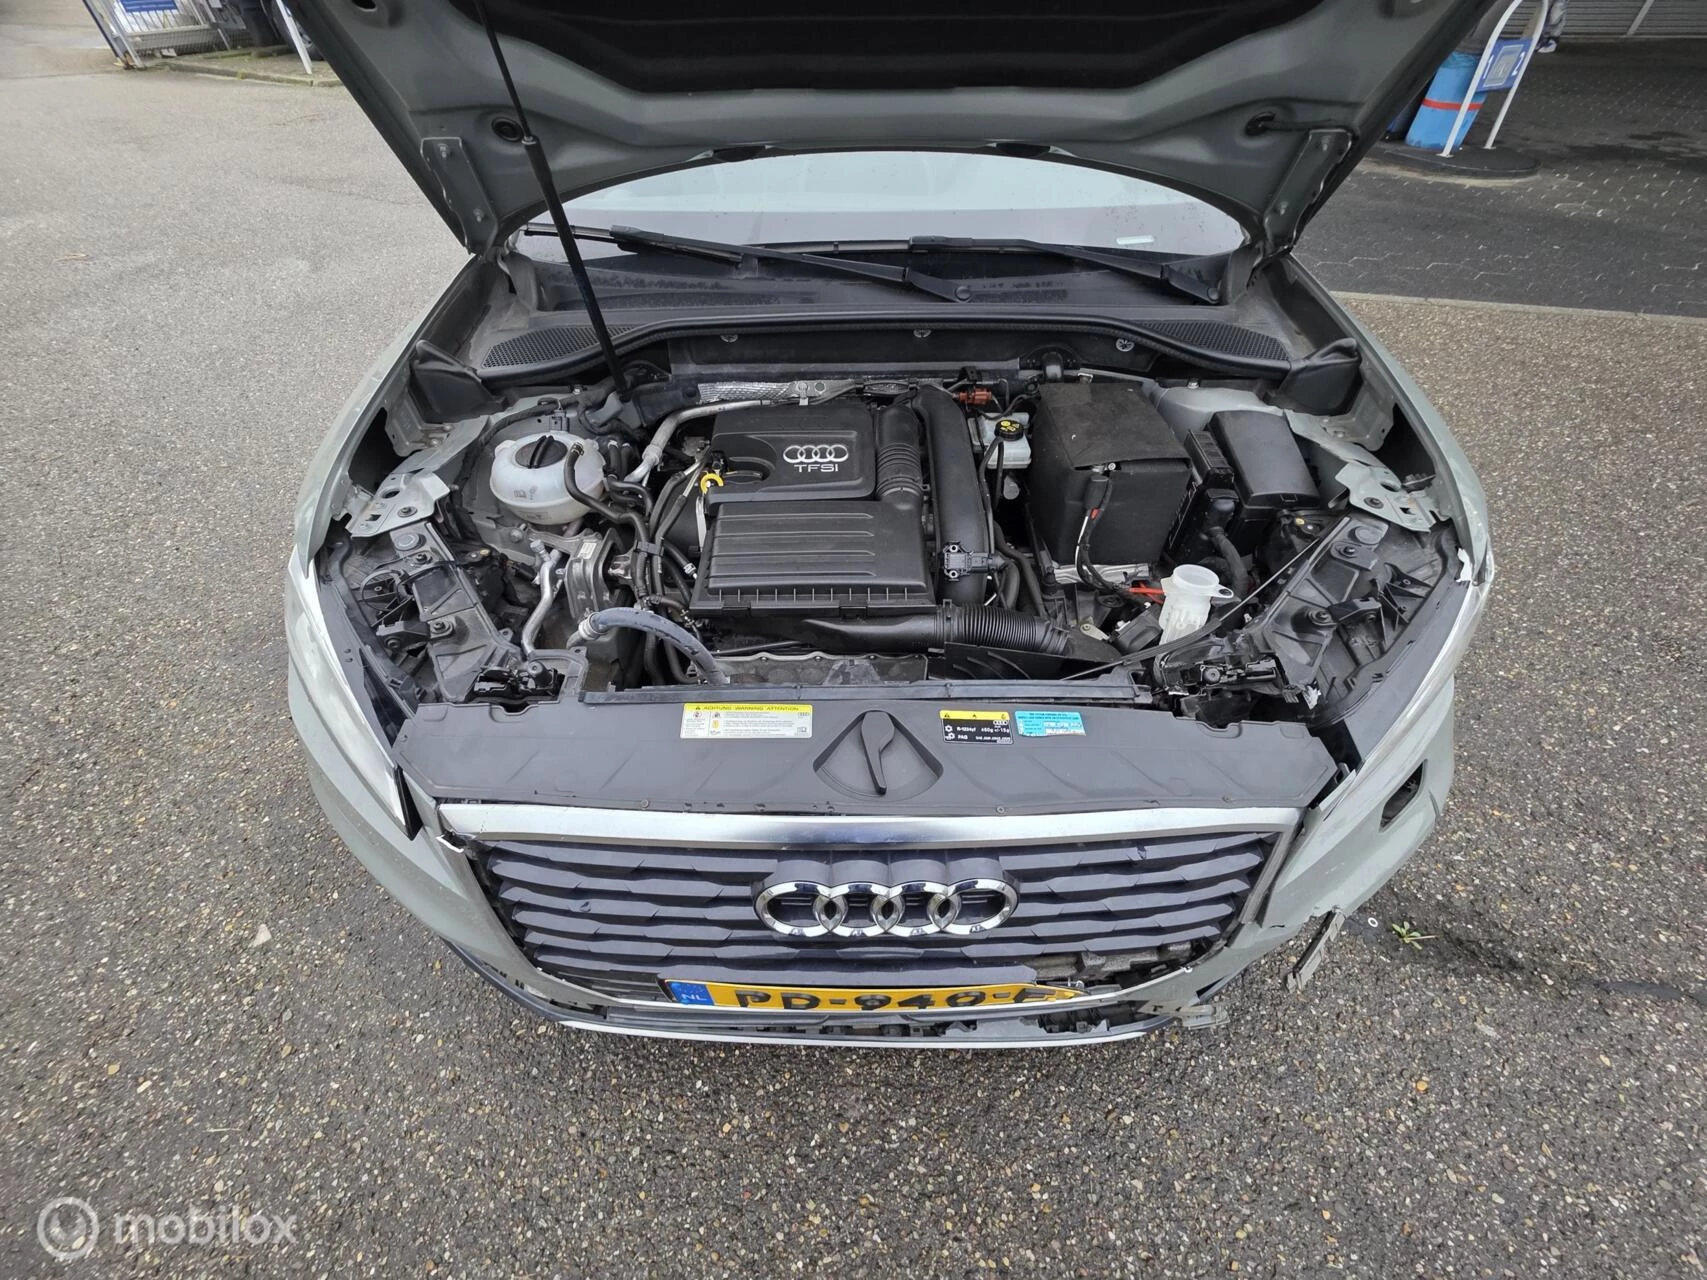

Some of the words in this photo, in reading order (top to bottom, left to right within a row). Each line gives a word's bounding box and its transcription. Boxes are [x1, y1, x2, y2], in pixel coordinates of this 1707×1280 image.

[1510, 51, 1527, 77] 2
[793, 463, 839, 473] TFSI
[681, 993, 709, 1001] NL
